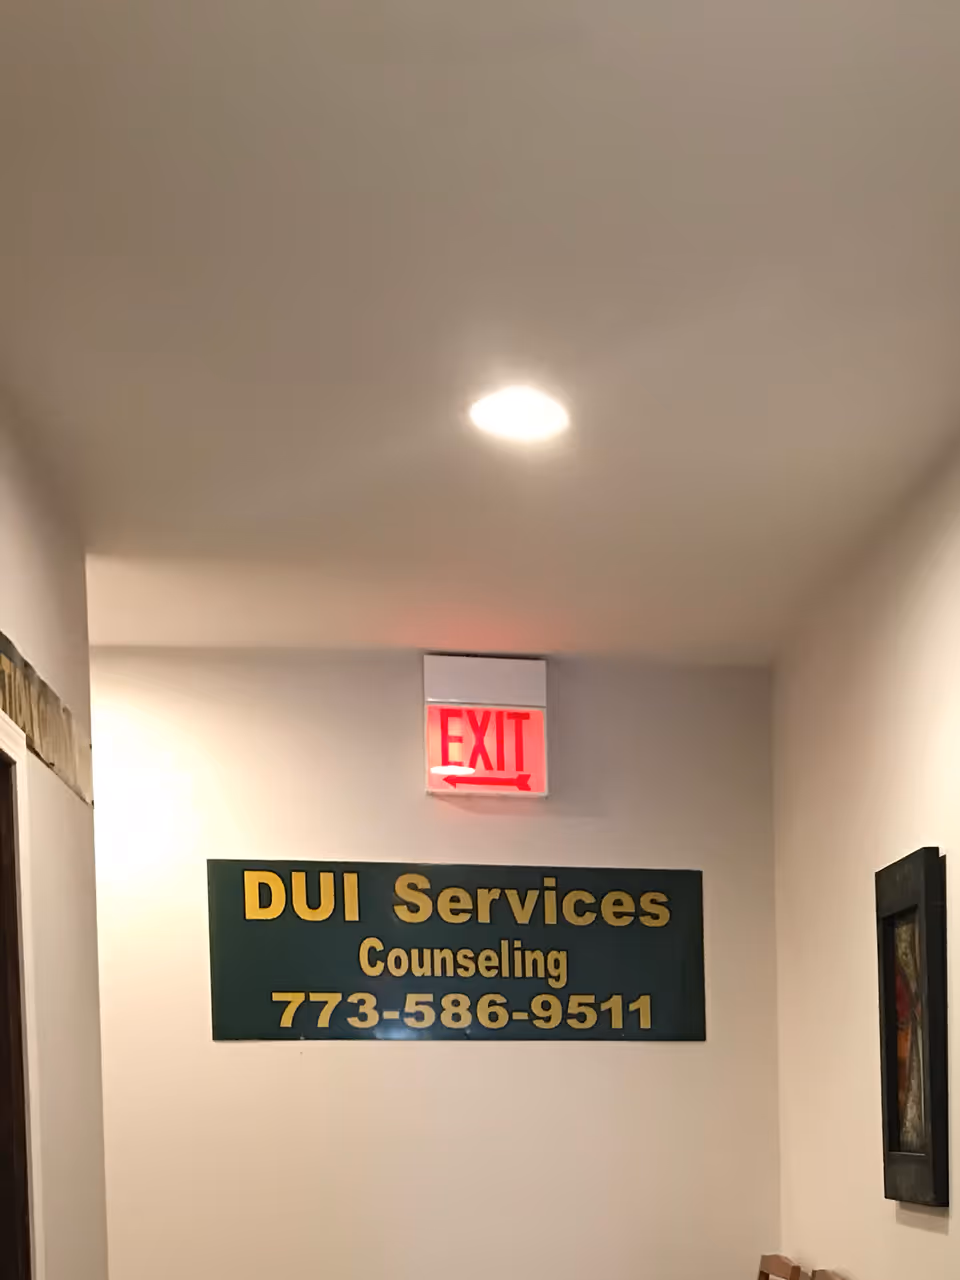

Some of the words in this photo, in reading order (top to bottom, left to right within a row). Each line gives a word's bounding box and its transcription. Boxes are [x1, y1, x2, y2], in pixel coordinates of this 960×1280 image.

[440, 708, 530, 772] EXIT
[243, 870, 360, 922] DUI
[393, 873, 671, 927] Services
[359, 937, 568, 988] Counseling
[271, 992, 652, 1029] 773-586-9511
